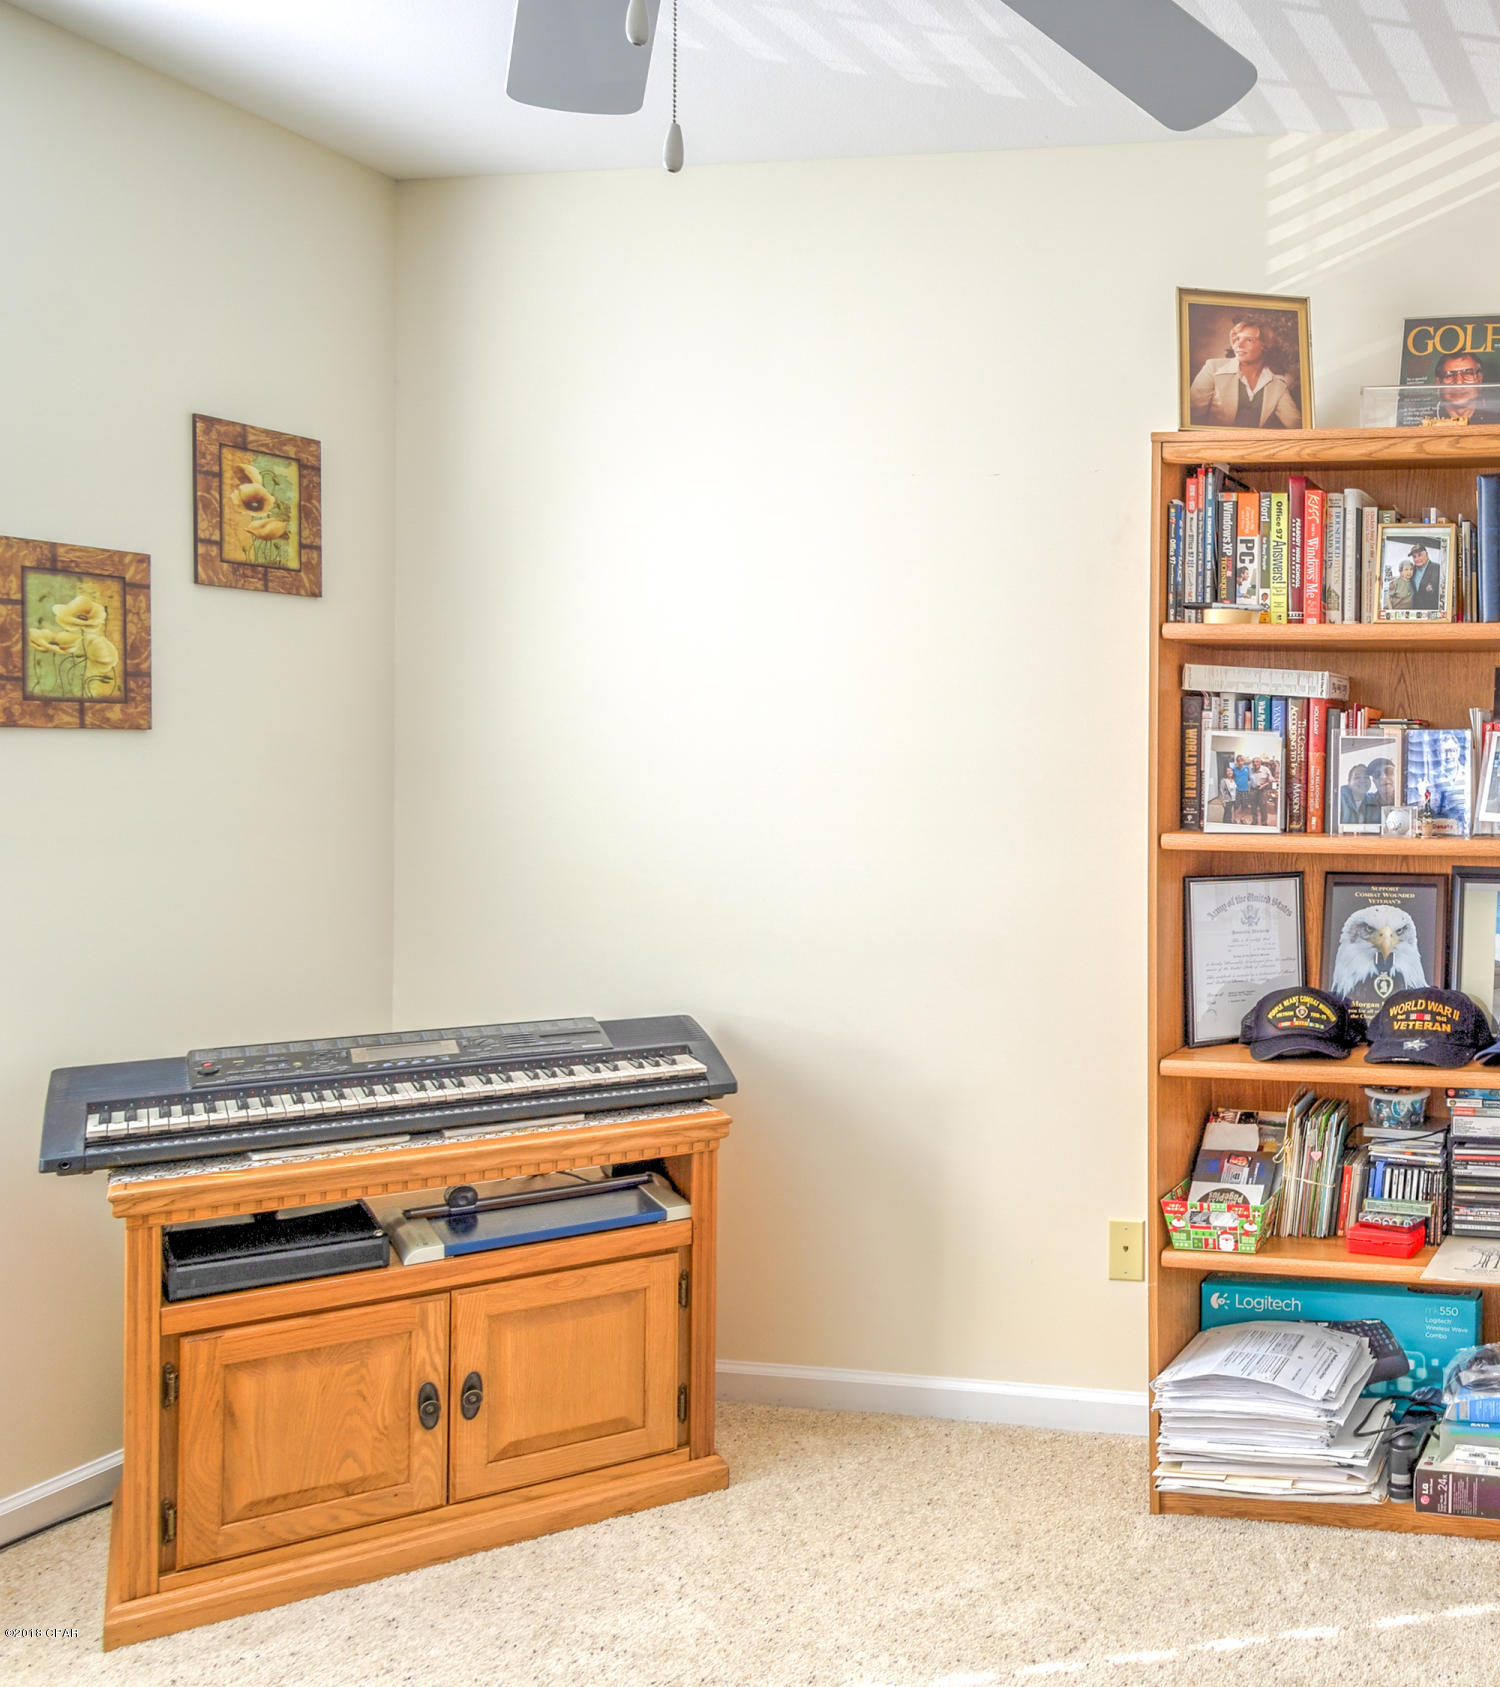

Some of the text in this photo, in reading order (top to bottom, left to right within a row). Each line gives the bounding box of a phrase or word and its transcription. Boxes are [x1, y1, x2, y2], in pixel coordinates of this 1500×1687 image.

[1261, 498, 1270, 522] Word
[1222, 502, 1233, 556] Windows XP
[1276, 528, 1283, 540] 97
[1170, 556, 1176, 565] 97
[1239, 539, 1255, 564] PC
[1272, 540, 1287, 584] Answers!
[1306, 537, 1319, 599] Windows Me
[1290, 705, 1299, 751] ACCORDING
[1185, 728, 1198, 798] WORLD WAR II
[1292, 783, 1301, 813] MASON
[1236, 894, 1246, 903] the
[1246, 892, 1271, 904] United
[1270, 897, 1293, 917] States
[1351, 1000, 1380, 1009] Morgan
[1389, 999, 1461, 1021] WORLD WAR II
[1393, 1021, 1452, 1033] VETERAN
[1235, 1293, 1302, 1313] Logitech
[1440, 1306, 1459, 1317] 550
[1425, 1317, 1452, 1325] Logitech
[1425, 1332, 1448, 1340] Combo
[1422, 1483, 1429, 1495] LG
[1437, 1474, 1448, 1491] 24x
